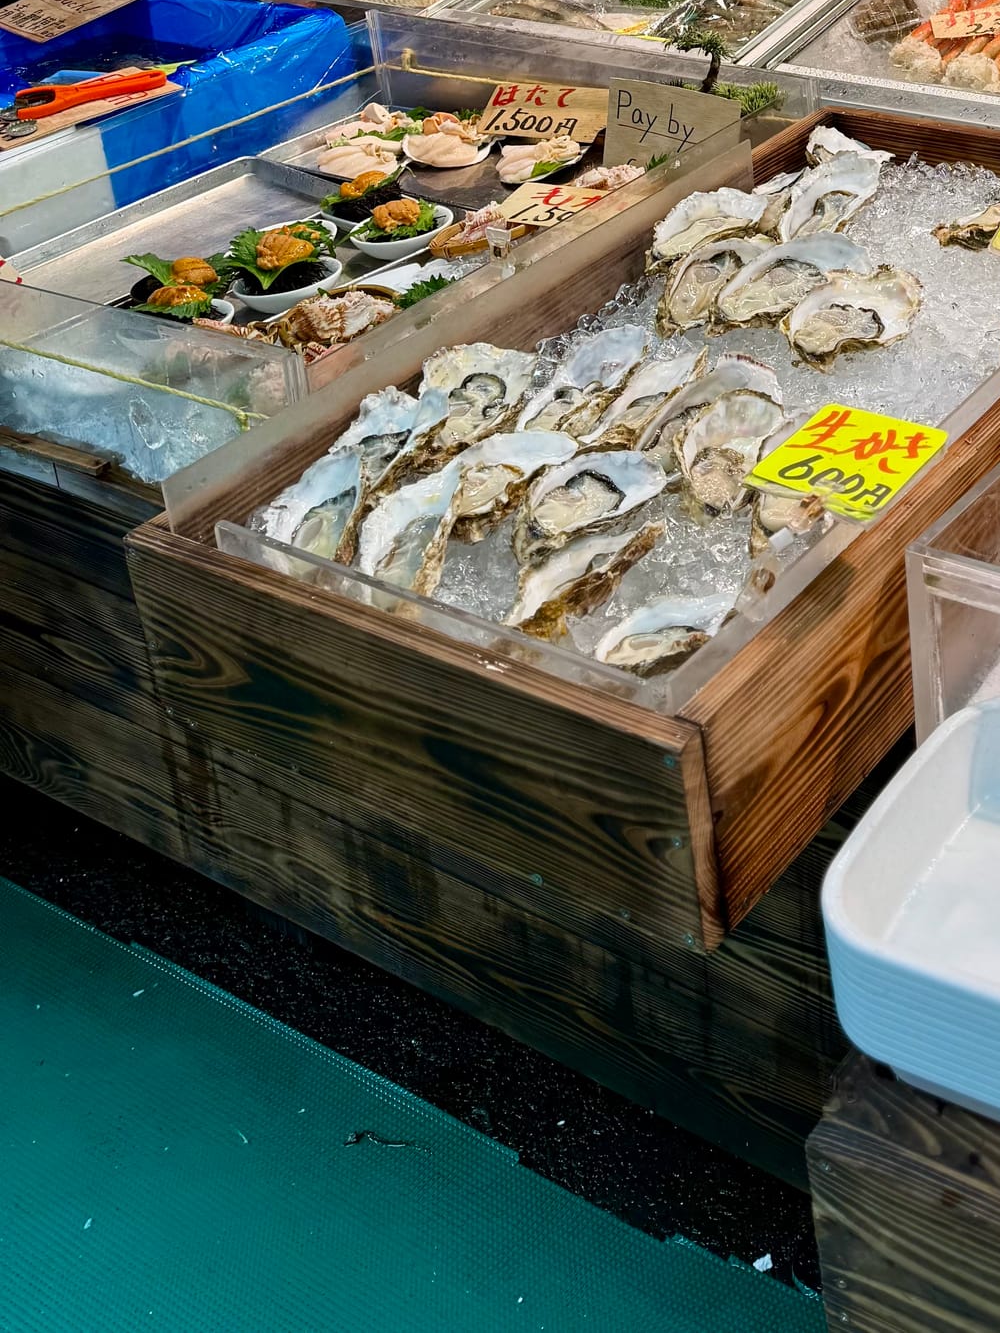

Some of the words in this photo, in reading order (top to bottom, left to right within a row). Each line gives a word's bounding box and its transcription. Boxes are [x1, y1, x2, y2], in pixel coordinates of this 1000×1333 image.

[491, 84, 577, 108] ほたて
[616, 89, 658, 143] Pay
[667, 103, 695, 153] by
[783, 409, 934, 475] 生かき
